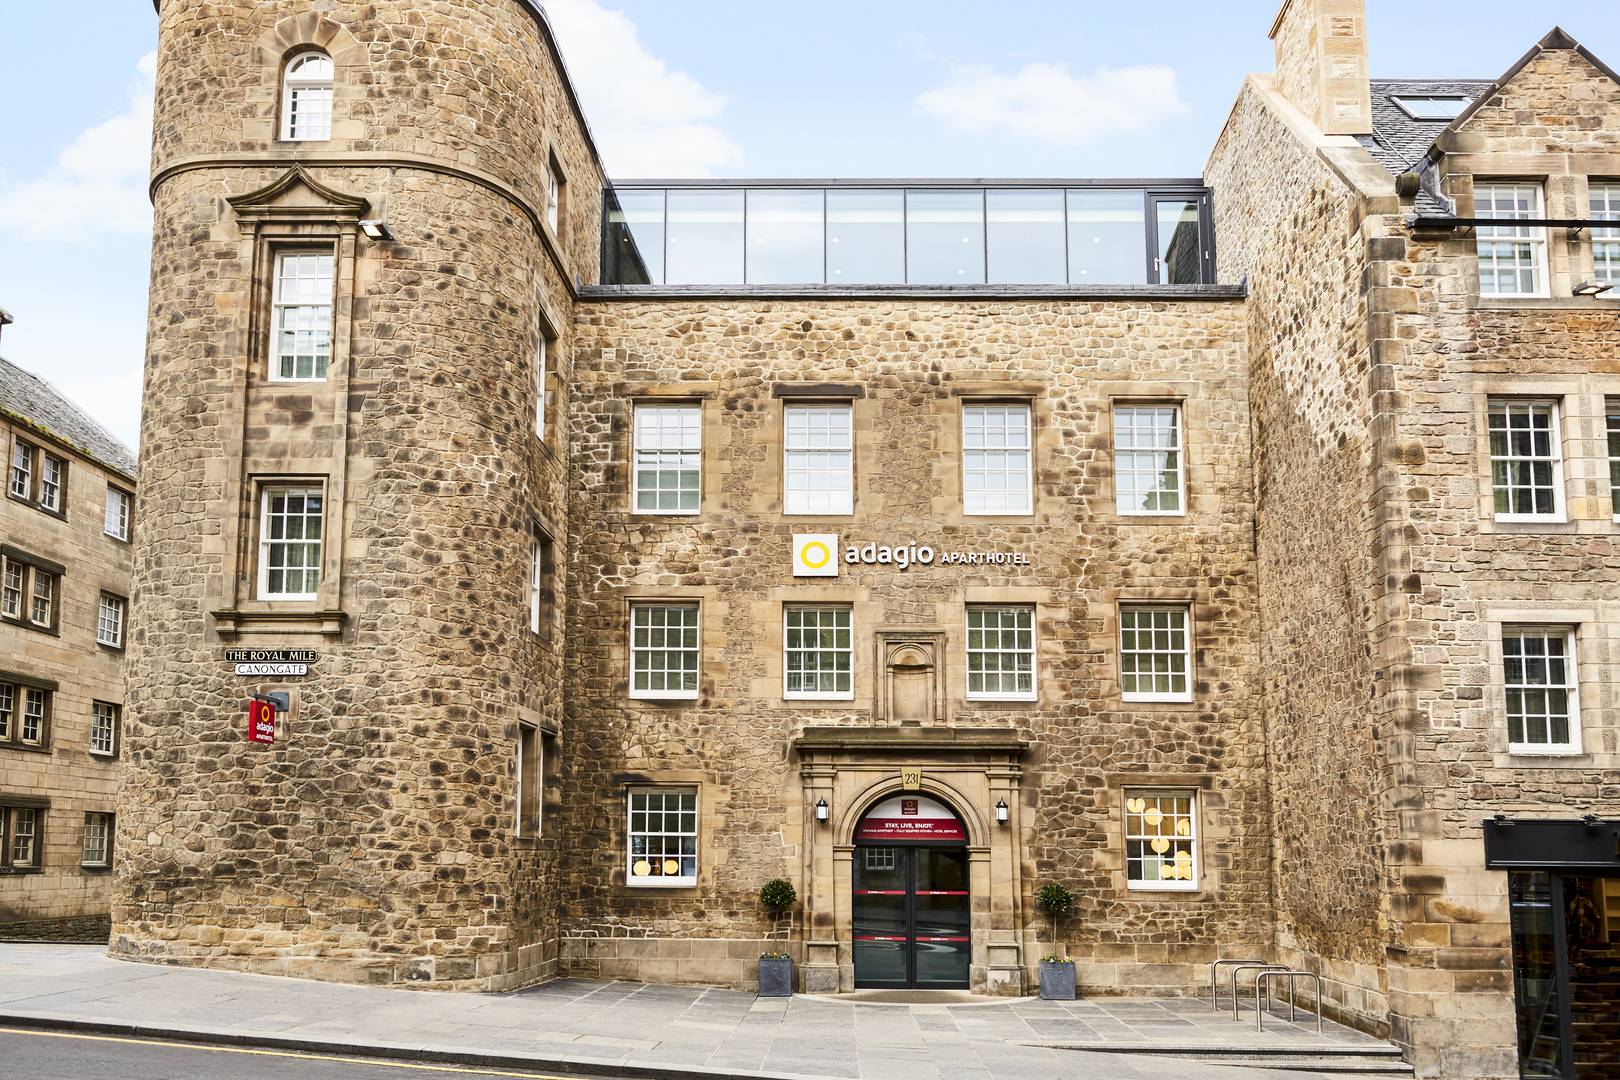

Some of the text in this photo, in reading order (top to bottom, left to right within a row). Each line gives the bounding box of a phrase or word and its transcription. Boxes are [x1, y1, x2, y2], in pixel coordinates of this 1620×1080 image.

[845, 541, 1030, 568] adagio APARTHOTEL
[228, 651, 314, 660] THE ROYAL MILE
[238, 665, 304, 673] CANONGATE
[256, 722, 273, 734] adagio
[904, 773, 919, 785] 231
